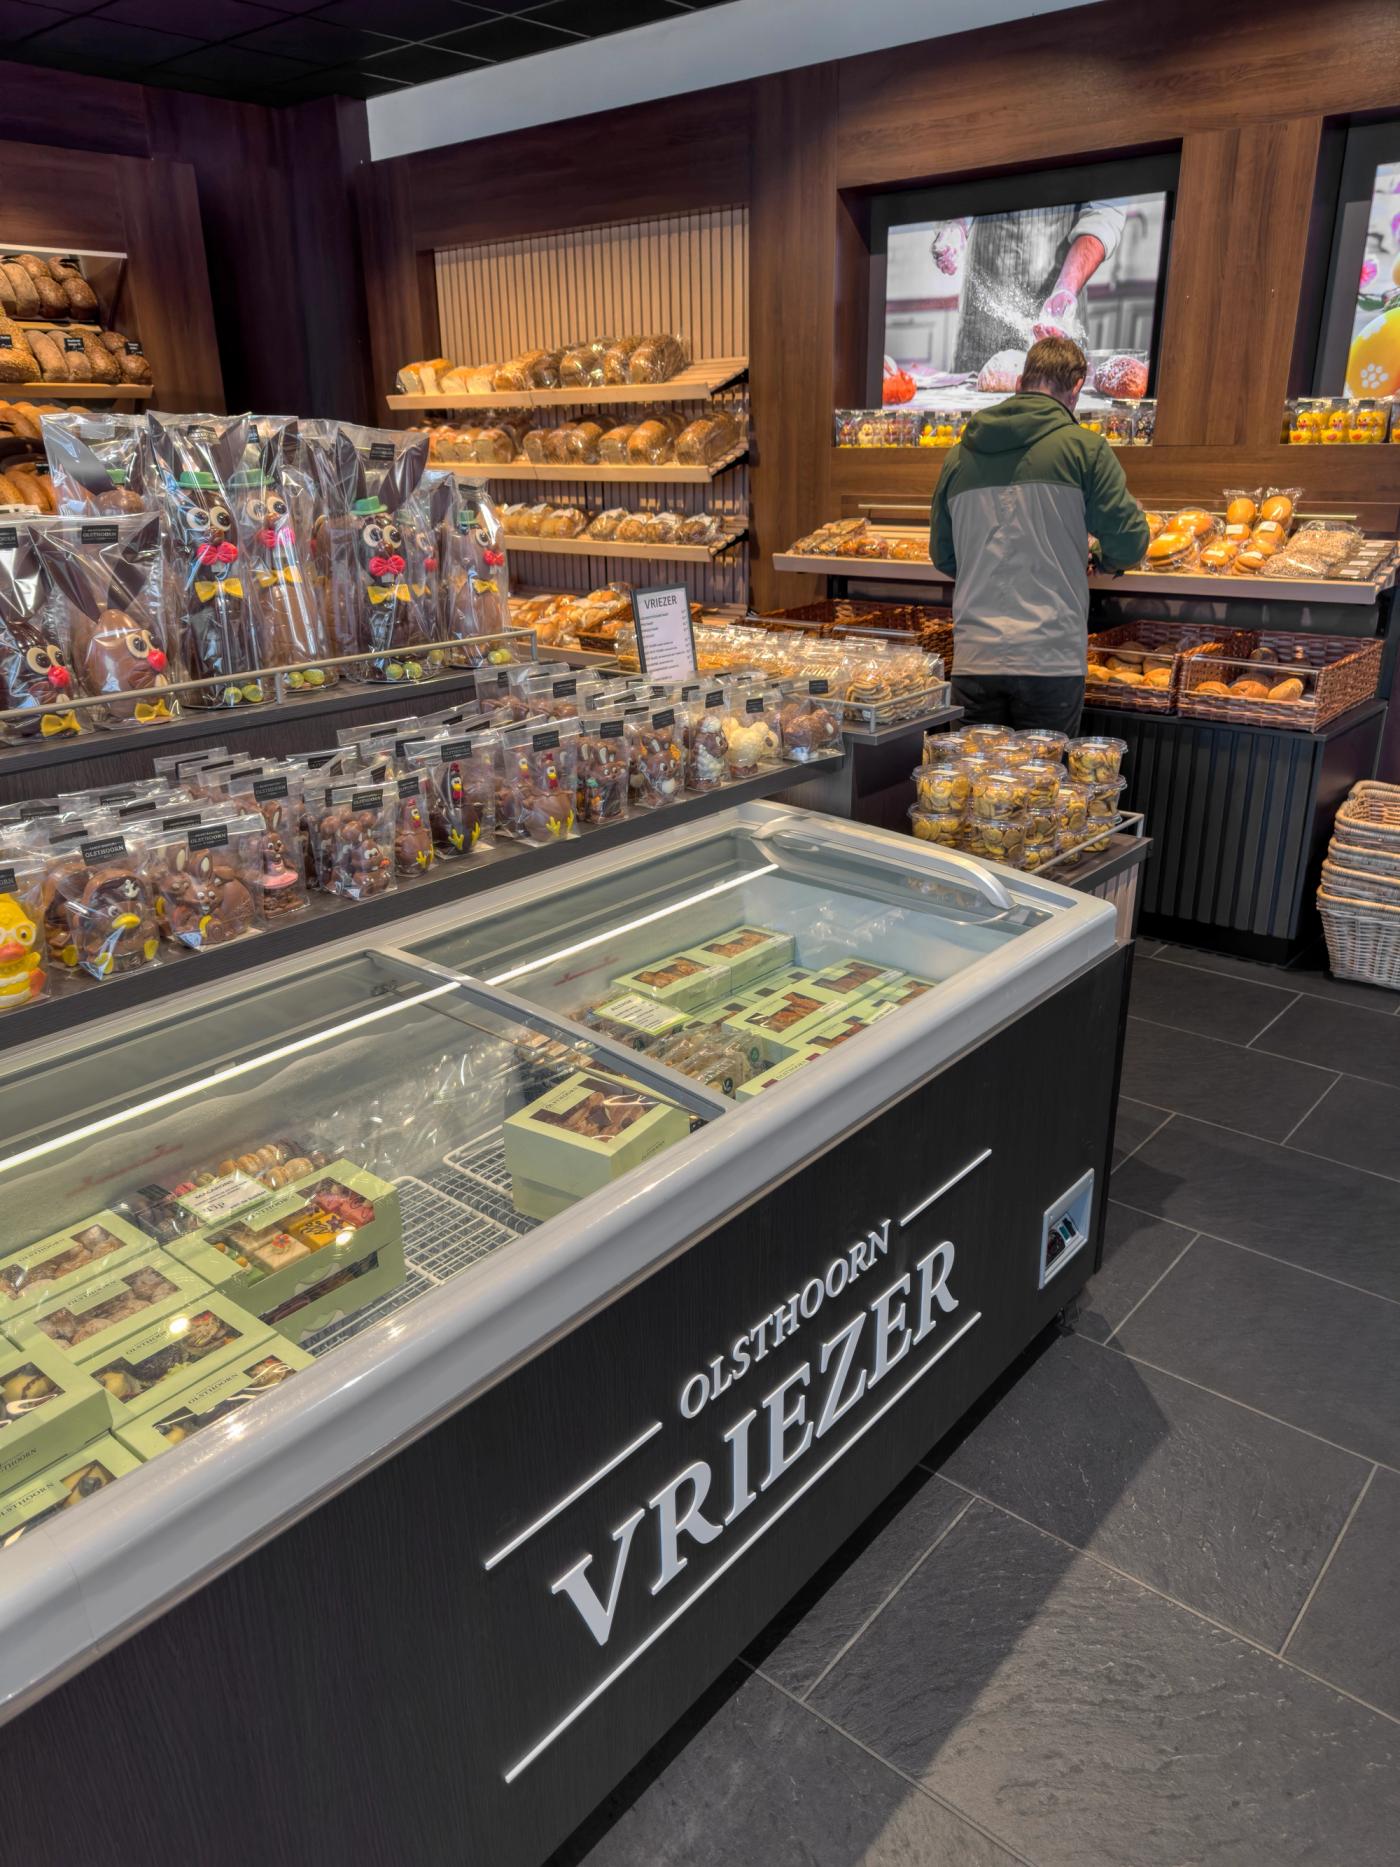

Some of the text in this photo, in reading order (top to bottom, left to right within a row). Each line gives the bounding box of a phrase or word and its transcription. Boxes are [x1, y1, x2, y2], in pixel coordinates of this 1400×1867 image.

[644, 595, 678, 609] VRIEZER
[679, 1219, 891, 1419] OLSTHOORN
[552, 1241, 959, 1645] VRIEZER
